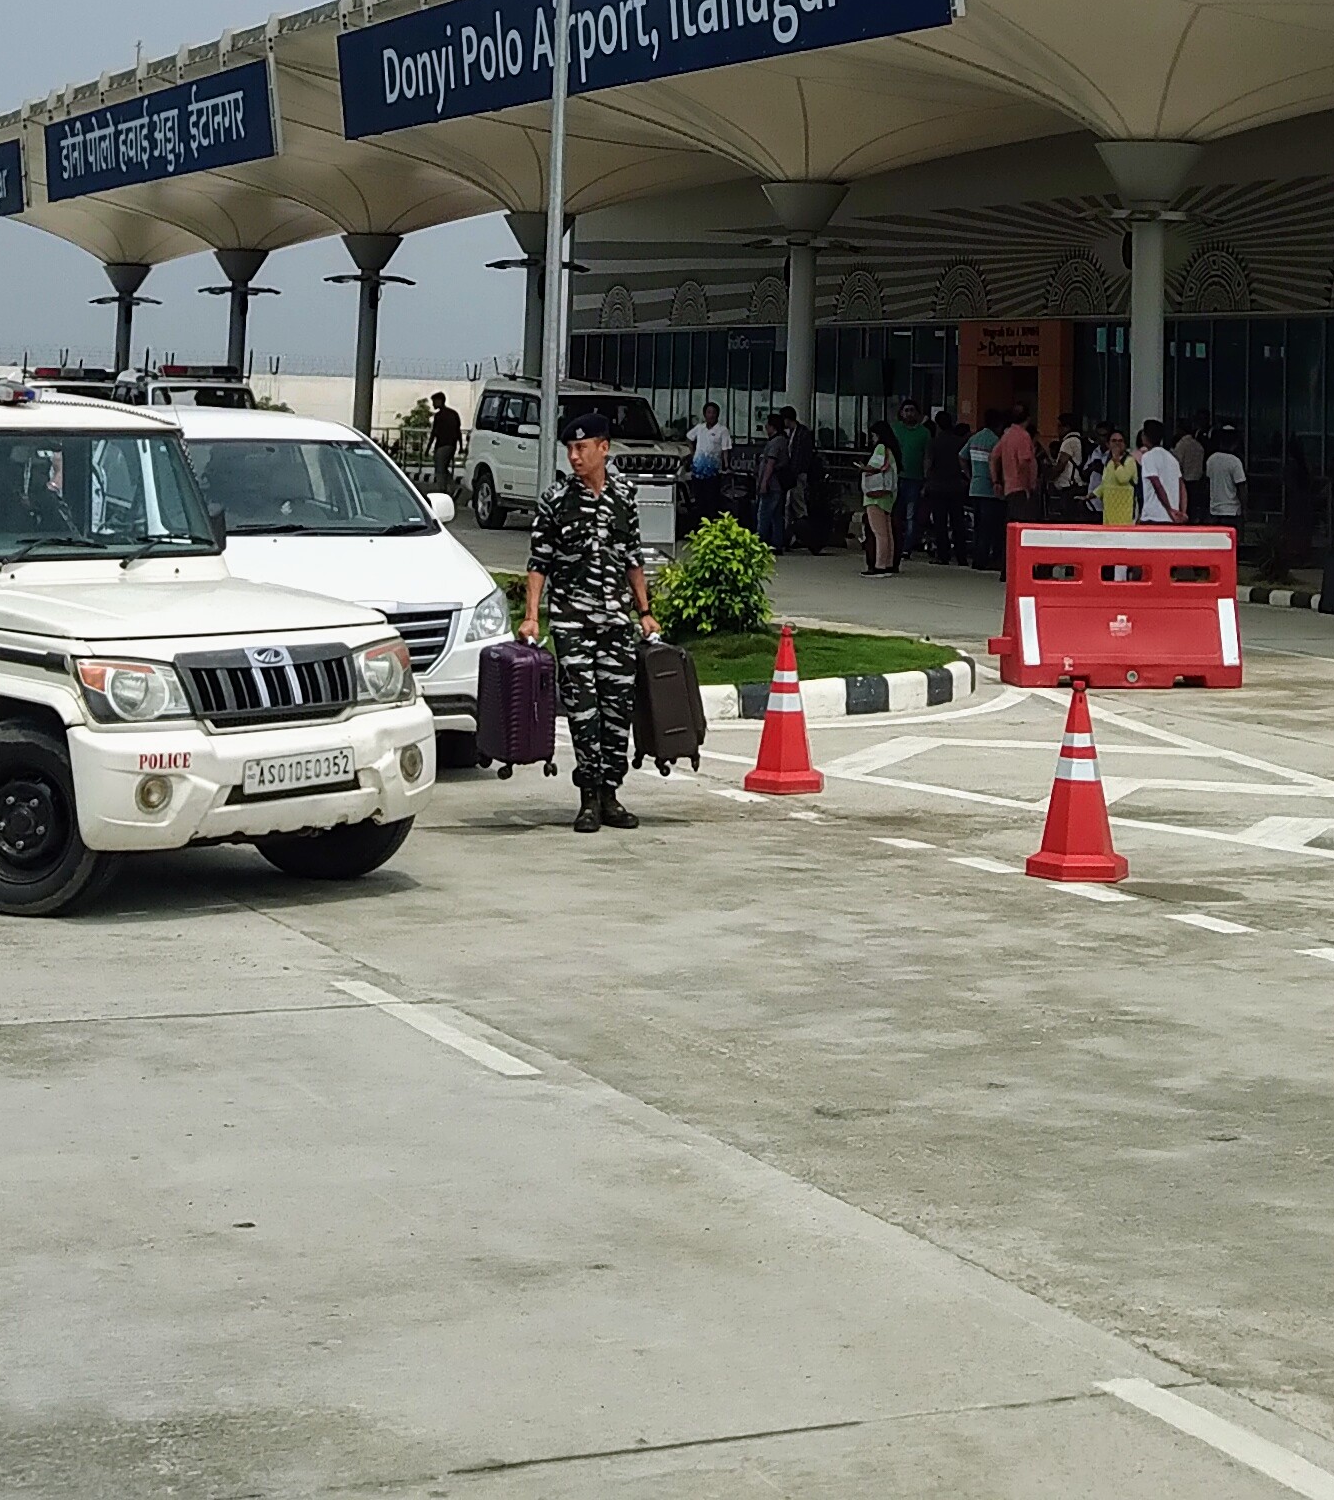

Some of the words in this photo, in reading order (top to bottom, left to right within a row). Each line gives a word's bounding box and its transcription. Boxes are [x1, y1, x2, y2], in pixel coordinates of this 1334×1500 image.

[382, 23, 455, 114] Donyi
[462, 10, 524, 84] Polo
[60, 120, 85, 180] डोनी
[86, 112, 115, 173] पोलो
[118, 98, 150, 173] हवाई
[188, 84, 245, 159] ईटानगर
[988, 342, 1039, 363] Departure
[139, 751, 192, 770] POLICE
[257, 754, 350, 787] AS01DE0352
